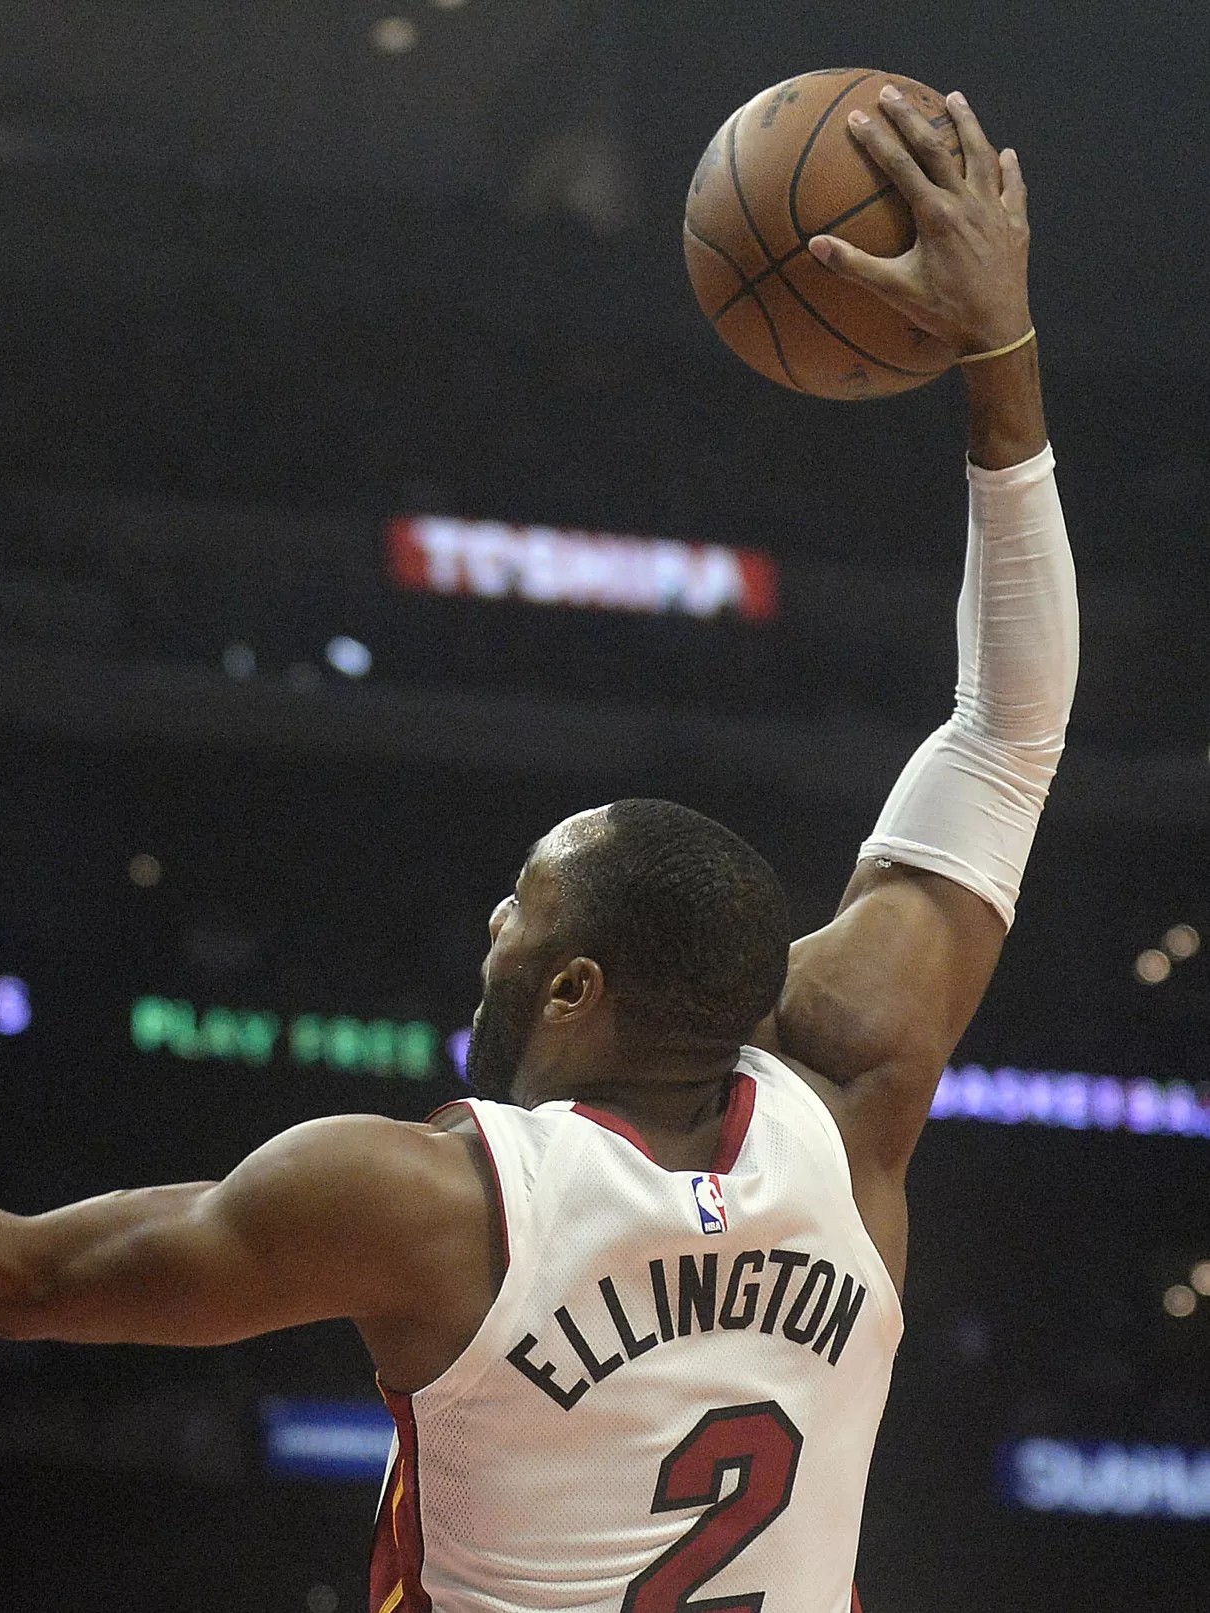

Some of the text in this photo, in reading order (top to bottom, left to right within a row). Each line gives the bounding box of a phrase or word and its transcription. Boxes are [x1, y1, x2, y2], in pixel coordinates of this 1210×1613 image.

[414, 517, 742, 616] TOSHIBA
[505, 1249, 866, 1411] ELLINGTON
[621, 1400, 804, 1613] 2
